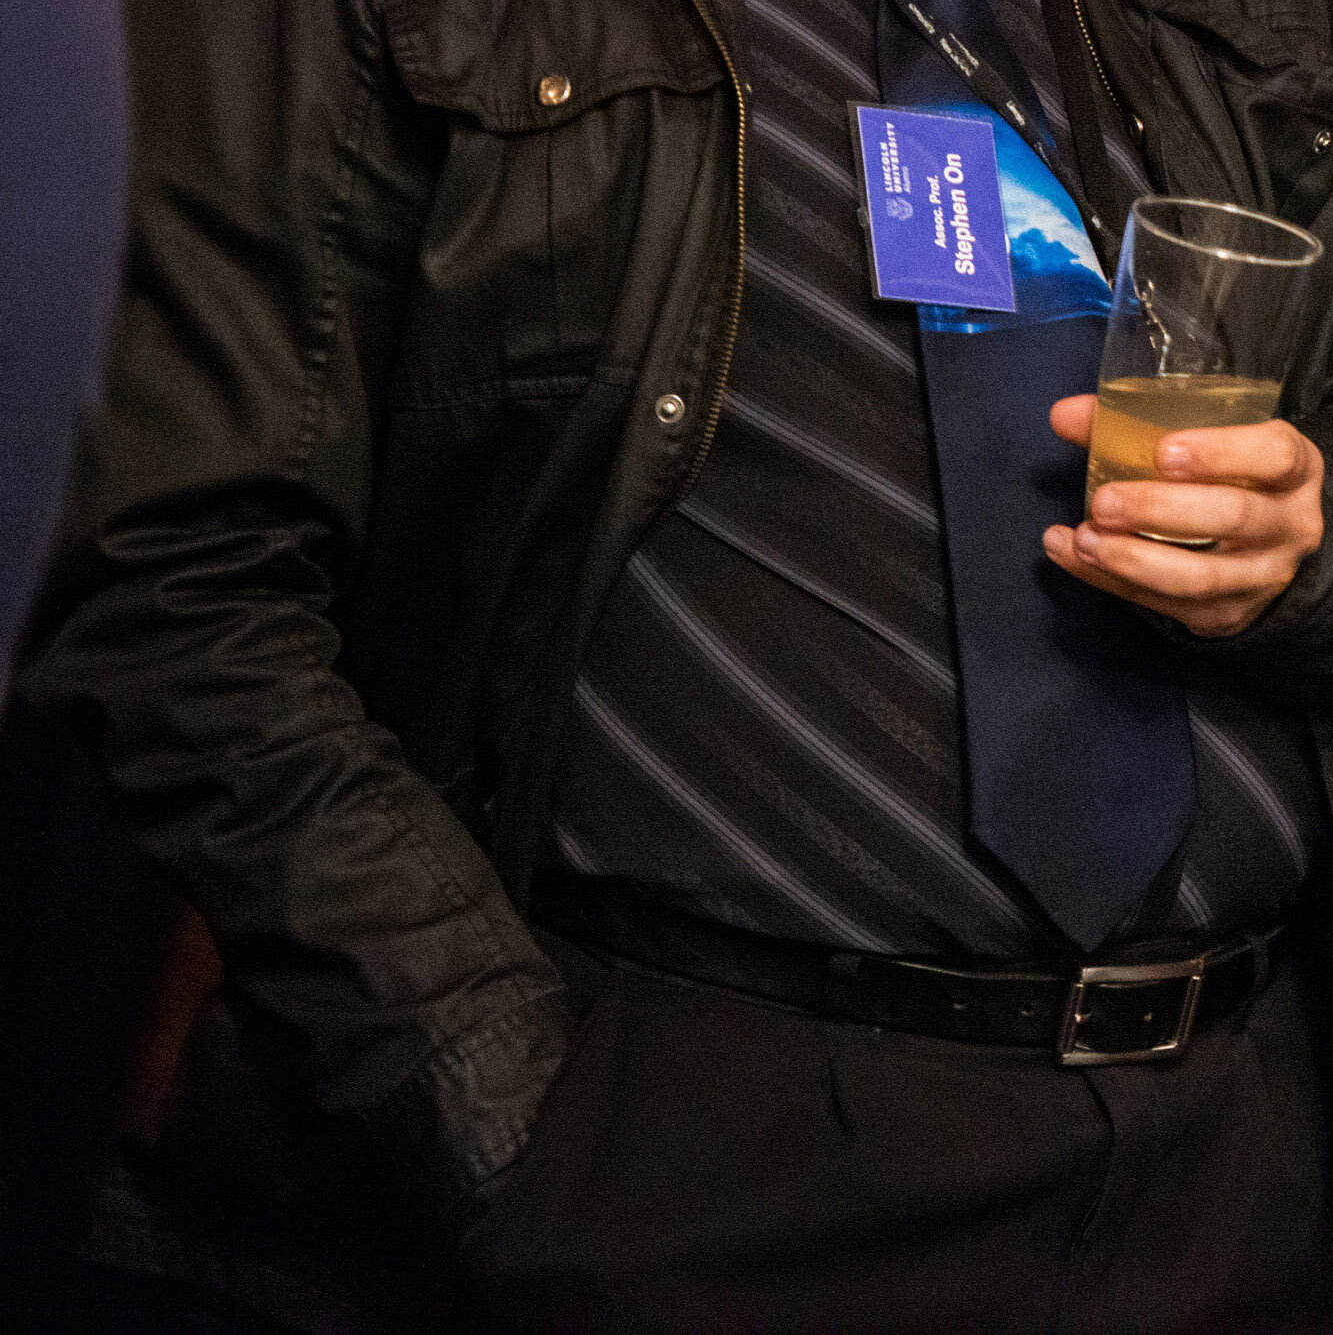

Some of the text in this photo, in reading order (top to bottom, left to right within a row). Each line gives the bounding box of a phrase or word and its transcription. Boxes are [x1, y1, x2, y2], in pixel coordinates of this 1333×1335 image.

[880, 142, 893, 193] LINCOLN
[886, 122, 902, 193] UNIVERSITY
[927, 175, 947, 249] Assoc. Prof.
[944, 153, 976, 275] Stephen On
